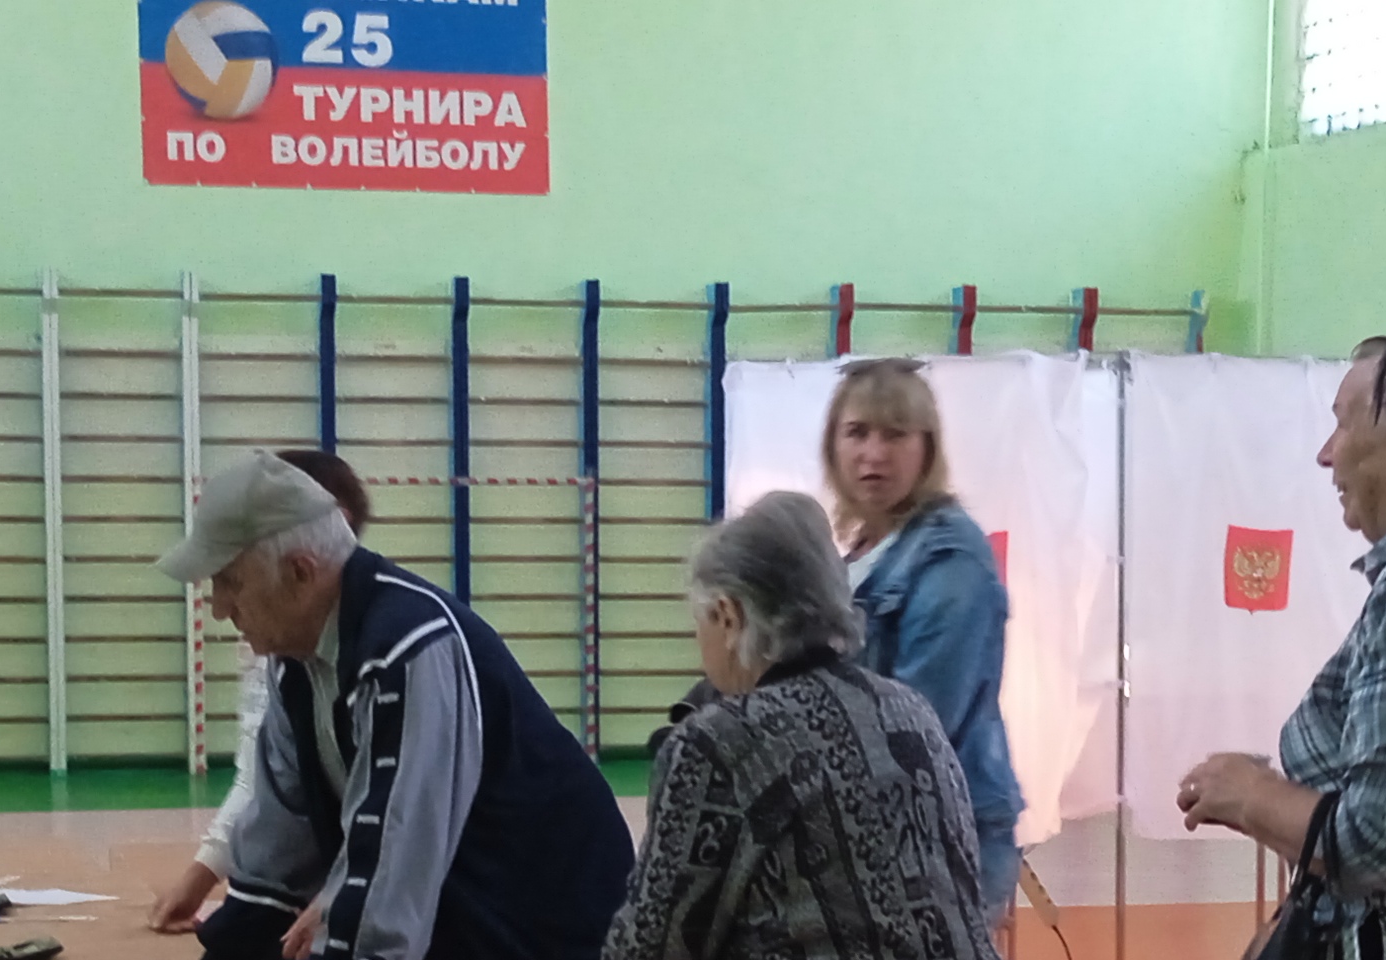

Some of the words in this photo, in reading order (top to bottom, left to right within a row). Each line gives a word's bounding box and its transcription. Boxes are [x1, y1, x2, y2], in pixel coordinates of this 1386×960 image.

[301, 10, 393, 68] 25
[292, 83, 527, 128] ТУРНИРА
[167, 131, 227, 163] ПО
[271, 129, 526, 171] ВОЛЕЙБОЛУ
